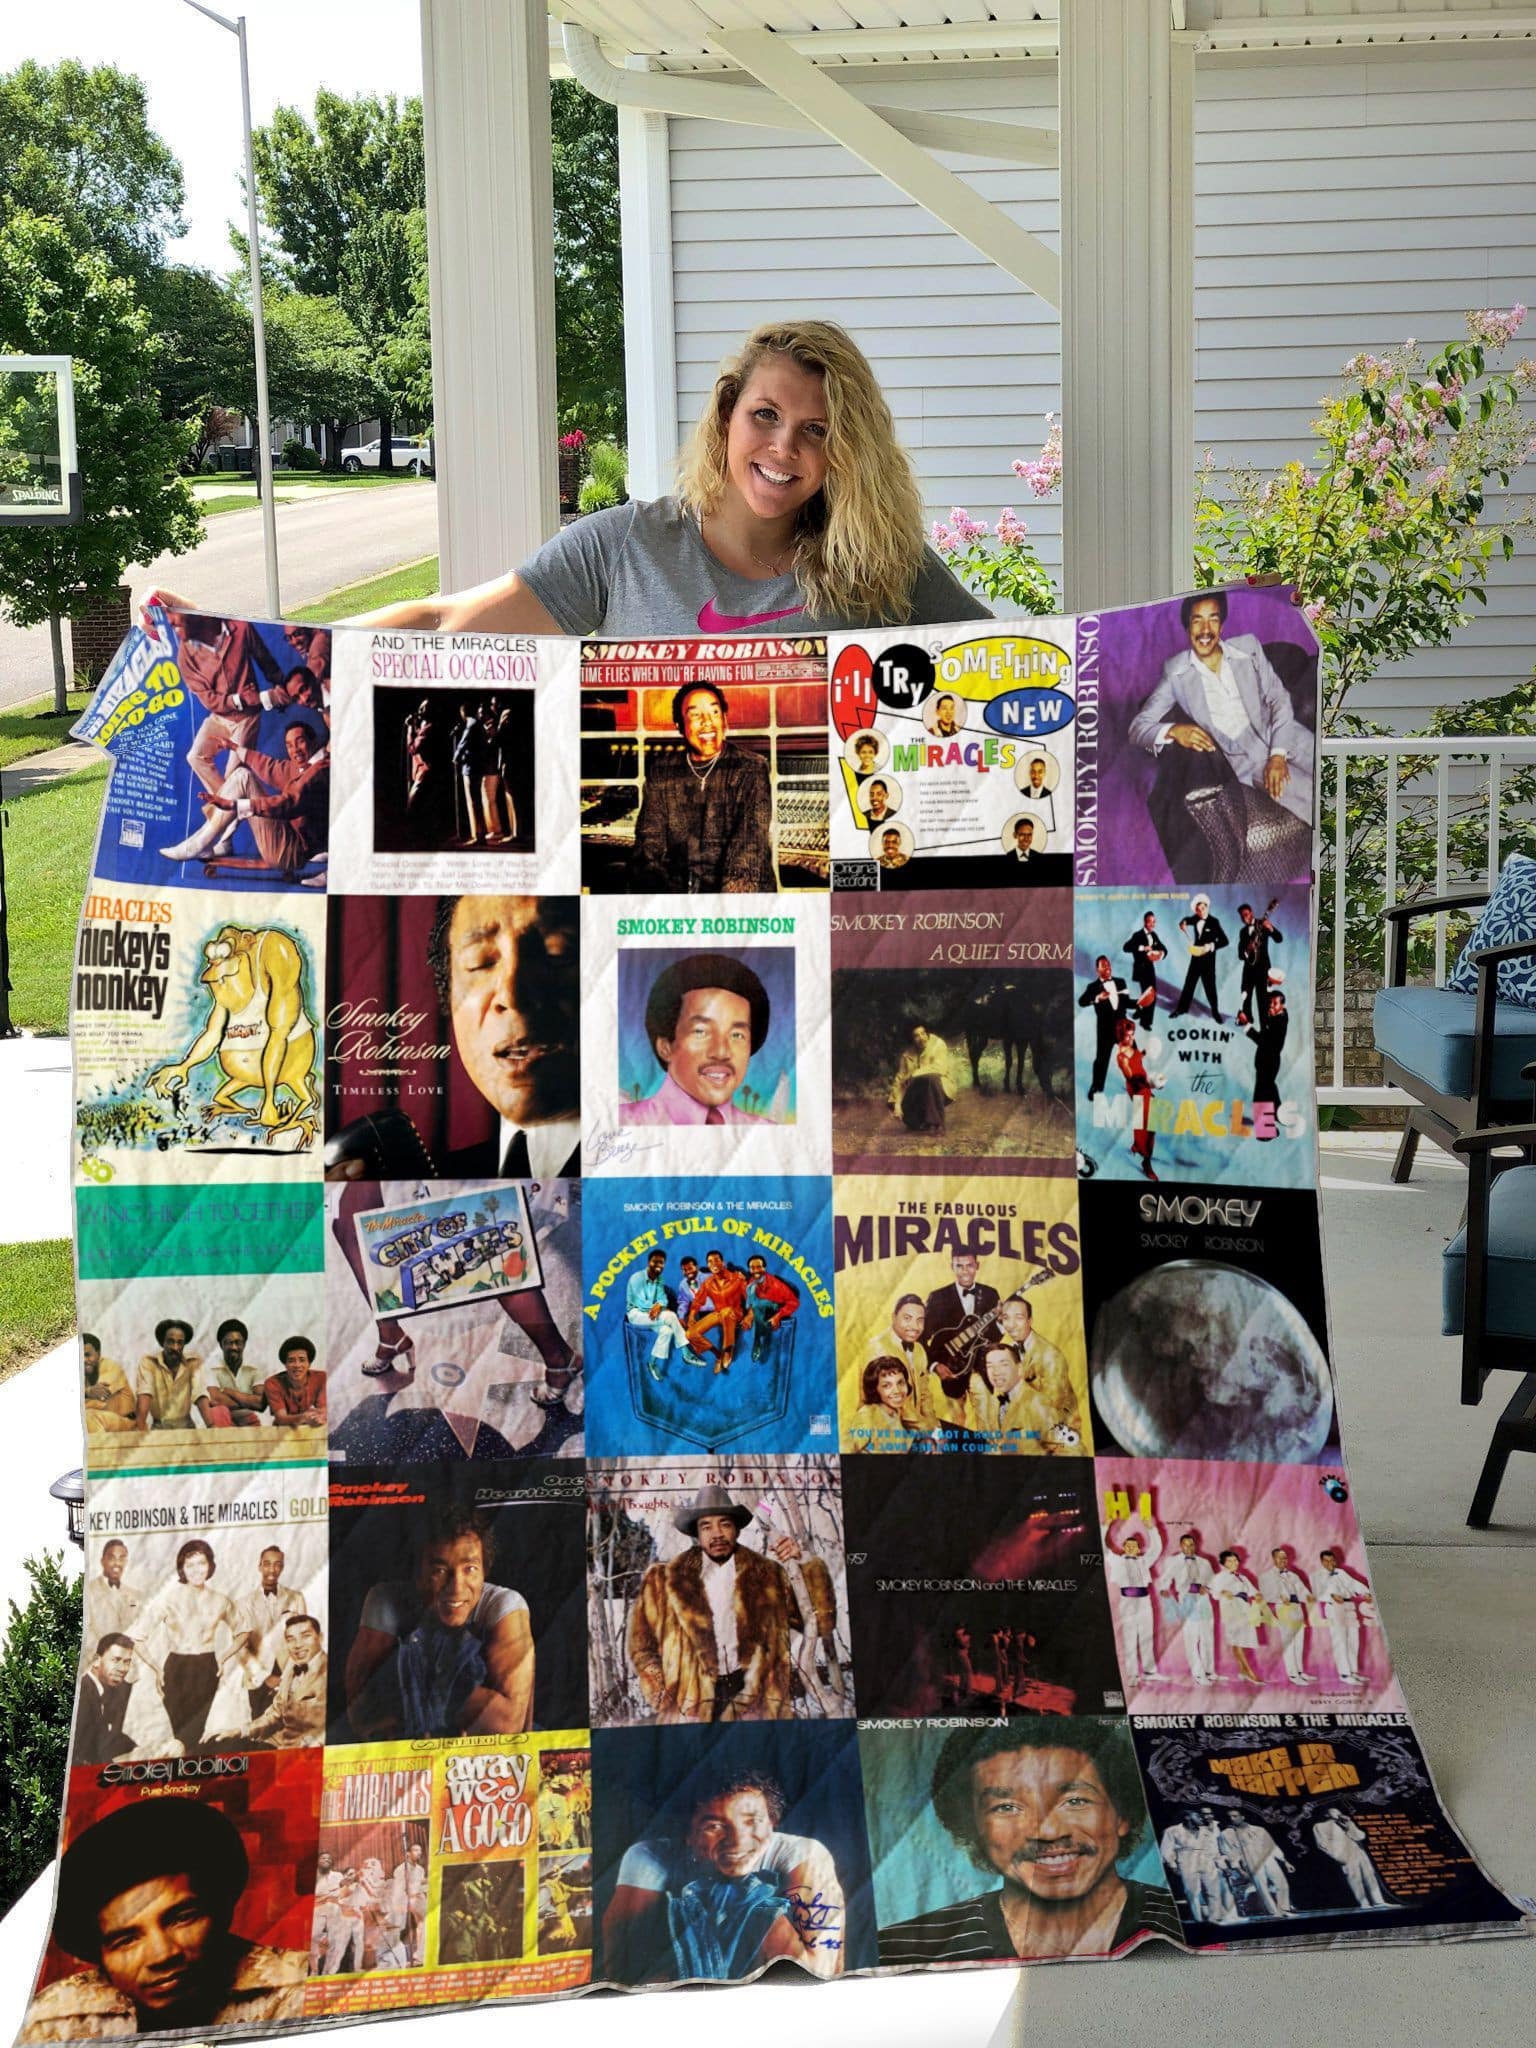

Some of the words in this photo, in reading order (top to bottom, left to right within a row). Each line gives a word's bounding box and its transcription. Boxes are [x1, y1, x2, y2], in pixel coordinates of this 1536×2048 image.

[12, 489, 59, 502] SPALDING
[371, 635, 405, 650] AND
[412, 637, 445, 650] THE
[452, 637, 537, 653] MIRACLES
[582, 642, 694, 661] SMOKEY
[695, 638, 827, 661] ROBINSON
[145, 661, 181, 692] TO
[371, 652, 443, 679] SPECIAL
[449, 653, 538, 682] OCCASION
[581, 666, 603, 682] TIME
[605, 666, 632, 682] FLIES
[632, 665, 660, 682] WHEN
[698, 663, 734, 682] HAVING
[735, 663, 754, 680] FUN
[1077, 614, 1101, 748] ROBINSO
[1002, 699, 1063, 731] NEW
[893, 738, 1016, 773] MIRACLES
[1077, 758, 1098, 887] SMOKEY
[617, 918, 698, 936] SMOKEY
[701, 917, 796, 935] ROBINSON
[831, 914, 908, 932] SMOKEY
[912, 912, 1005, 931] ROBINSON
[928, 944, 944, 961] A
[947, 943, 1004, 964] QUIET
[1007, 942, 1074, 961] STORM
[326, 998, 429, 1037] Smokey
[328, 1030, 451, 1064] Robinson
[1167, 1028, 1235, 1044] COOKIN'
[1178, 1051, 1222, 1064] WITH
[332, 1084, 400, 1096] TIMELESS
[407, 1084, 445, 1096] LOVE
[1184, 1070, 1226, 1095] the
[1092, 1091, 1307, 1139] MIRACLES
[623, 1202, 664, 1212] SMOKEY
[666, 1201, 716, 1211] ROBINSON
[717, 1201, 723, 1211] &
[725, 1201, 744, 1211] THE
[746, 1200, 793, 1211] MIRACLES
[898, 1201, 927, 1215] THE
[934, 1202, 1017, 1217] FABULOUS
[1139, 1193, 1263, 1228] SMOKEY
[661, 1215, 718, 1240] FULL
[722, 1217, 752, 1238] OF
[375, 1223, 435, 1268] CITY
[434, 1211, 469, 1239] OF
[834, 1214, 1081, 1276] MIRACLES
[1140, 1233, 1189, 1249] SMOKEY
[1204, 1235, 1265, 1253] ROBINSON
[405, 1221, 524, 1309] ANGELS
[590, 1229, 659, 1300] POCKET
[752, 1226, 835, 1319] MIRACLES
[583, 1303, 601, 1321] A
[328, 1482, 409, 1496] Smokey
[543, 1475, 585, 1487] One
[586, 1472, 688, 1490] SMOKEY
[706, 1471, 842, 1487] ROBINSON
[328, 1493, 426, 1508] Robinson
[475, 1487, 585, 1501] Heartbeat
[115, 1507, 176, 1529] ROBINSON
[180, 1506, 189, 1525] &
[193, 1504, 215, 1525] THE
[218, 1499, 279, 1522] MIRACLES
[289, 1497, 328, 1518] GOLD
[1104, 1490, 1152, 1521] HI
[1079, 1553, 1103, 1566] 1972
[875, 1579, 922, 1592] SMOKEY
[923, 1579, 983, 1592] ROBINSON
[983, 1580, 1005, 1591] and
[1005, 1579, 1025, 1591] THE
[1027, 1580, 1078, 1592] MIRACLES
[856, 1718, 923, 1731] SMOKEY
[926, 1716, 1010, 1730] ROBINSON
[1133, 1714, 1198, 1731] SMOKEY
[1203, 1714, 1282, 1730] ROBINSON
[1284, 1714, 1298, 1728] &
[1300, 1714, 1331, 1729] THE
[102, 1761, 174, 1784] Smokey
[178, 1755, 248, 1779] Robinson
[446, 1752, 533, 1801] away
[140, 1786, 163, 1798] Pure
[163, 1783, 201, 1796] Smokey
[343, 1769, 432, 1821] MIRACLES
[437, 1807, 464, 1855] A
